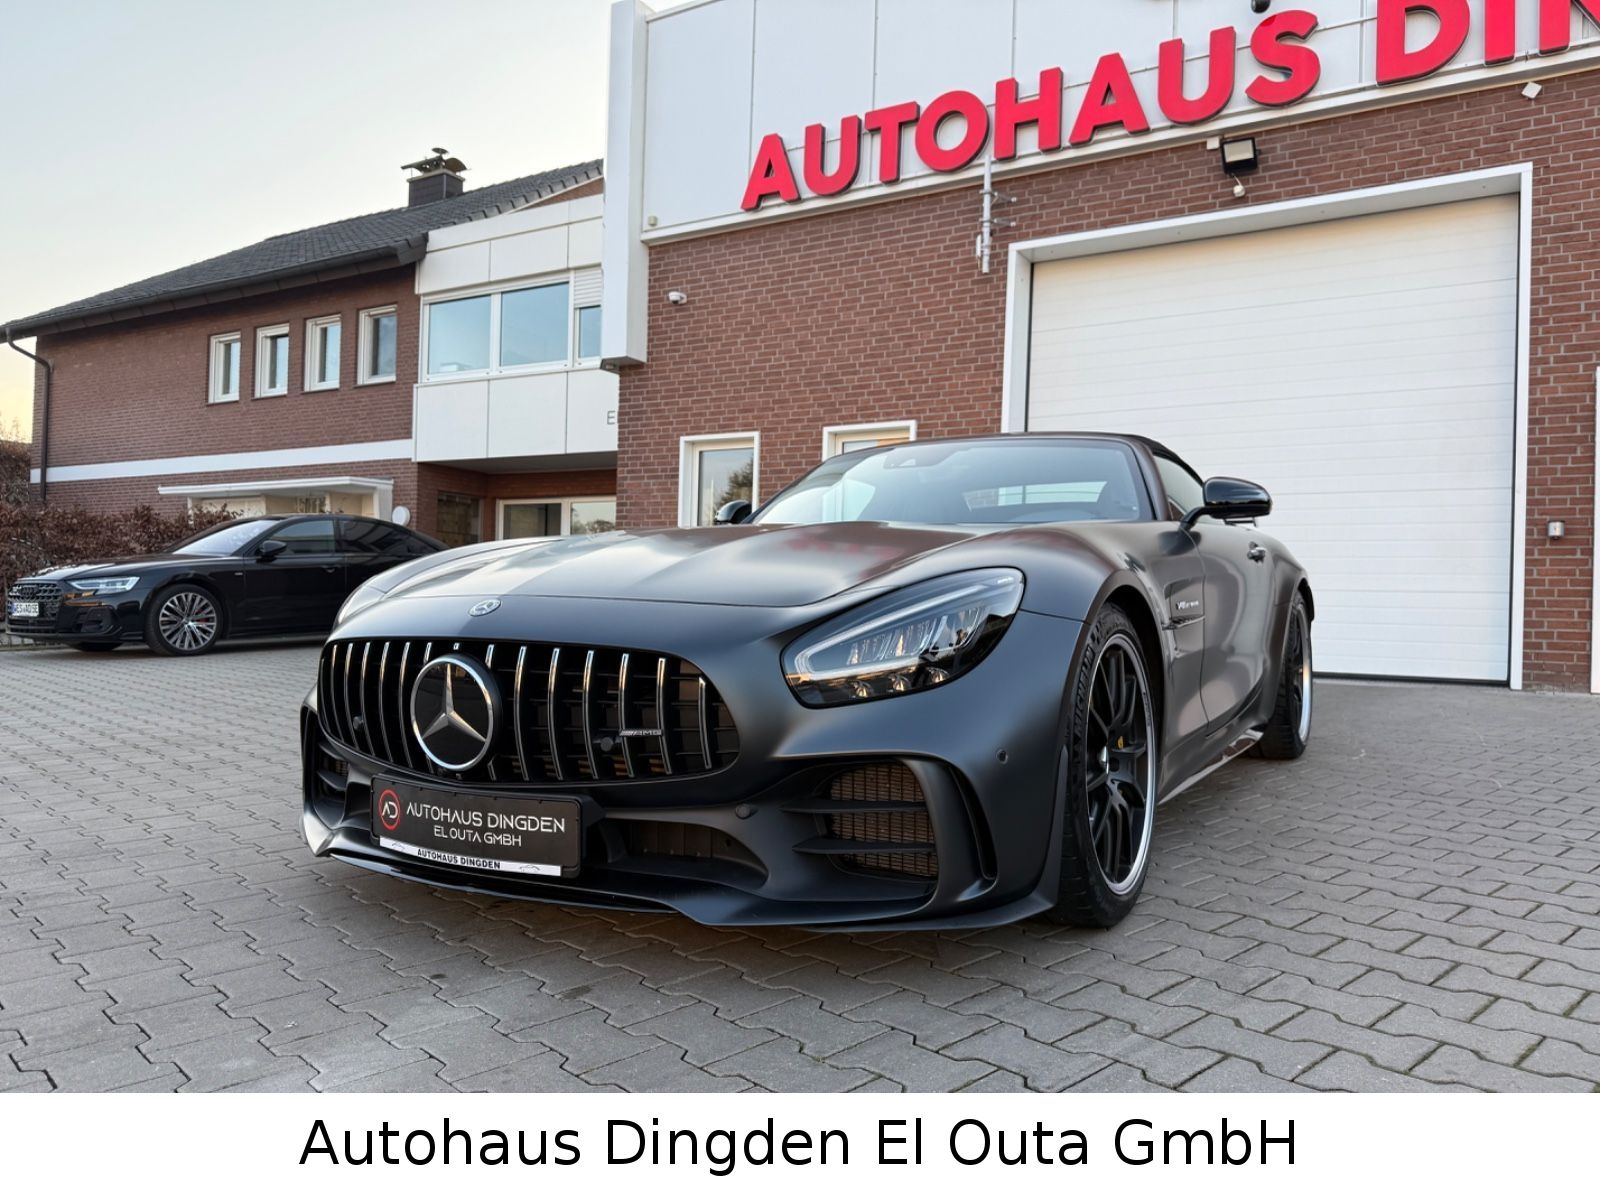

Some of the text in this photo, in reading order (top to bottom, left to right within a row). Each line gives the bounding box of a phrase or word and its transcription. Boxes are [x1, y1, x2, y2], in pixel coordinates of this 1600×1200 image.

[741, 0, 1600, 211] AUTOHAUS DI
[1073, 645, 1096, 736] MICHELIN
[406, 801, 565, 833] AUTOHAUS DINGDEN
[434, 825, 522, 847] EL OUTA GMBH
[417, 848, 501, 870] AUTOHAUS DINGDEN
